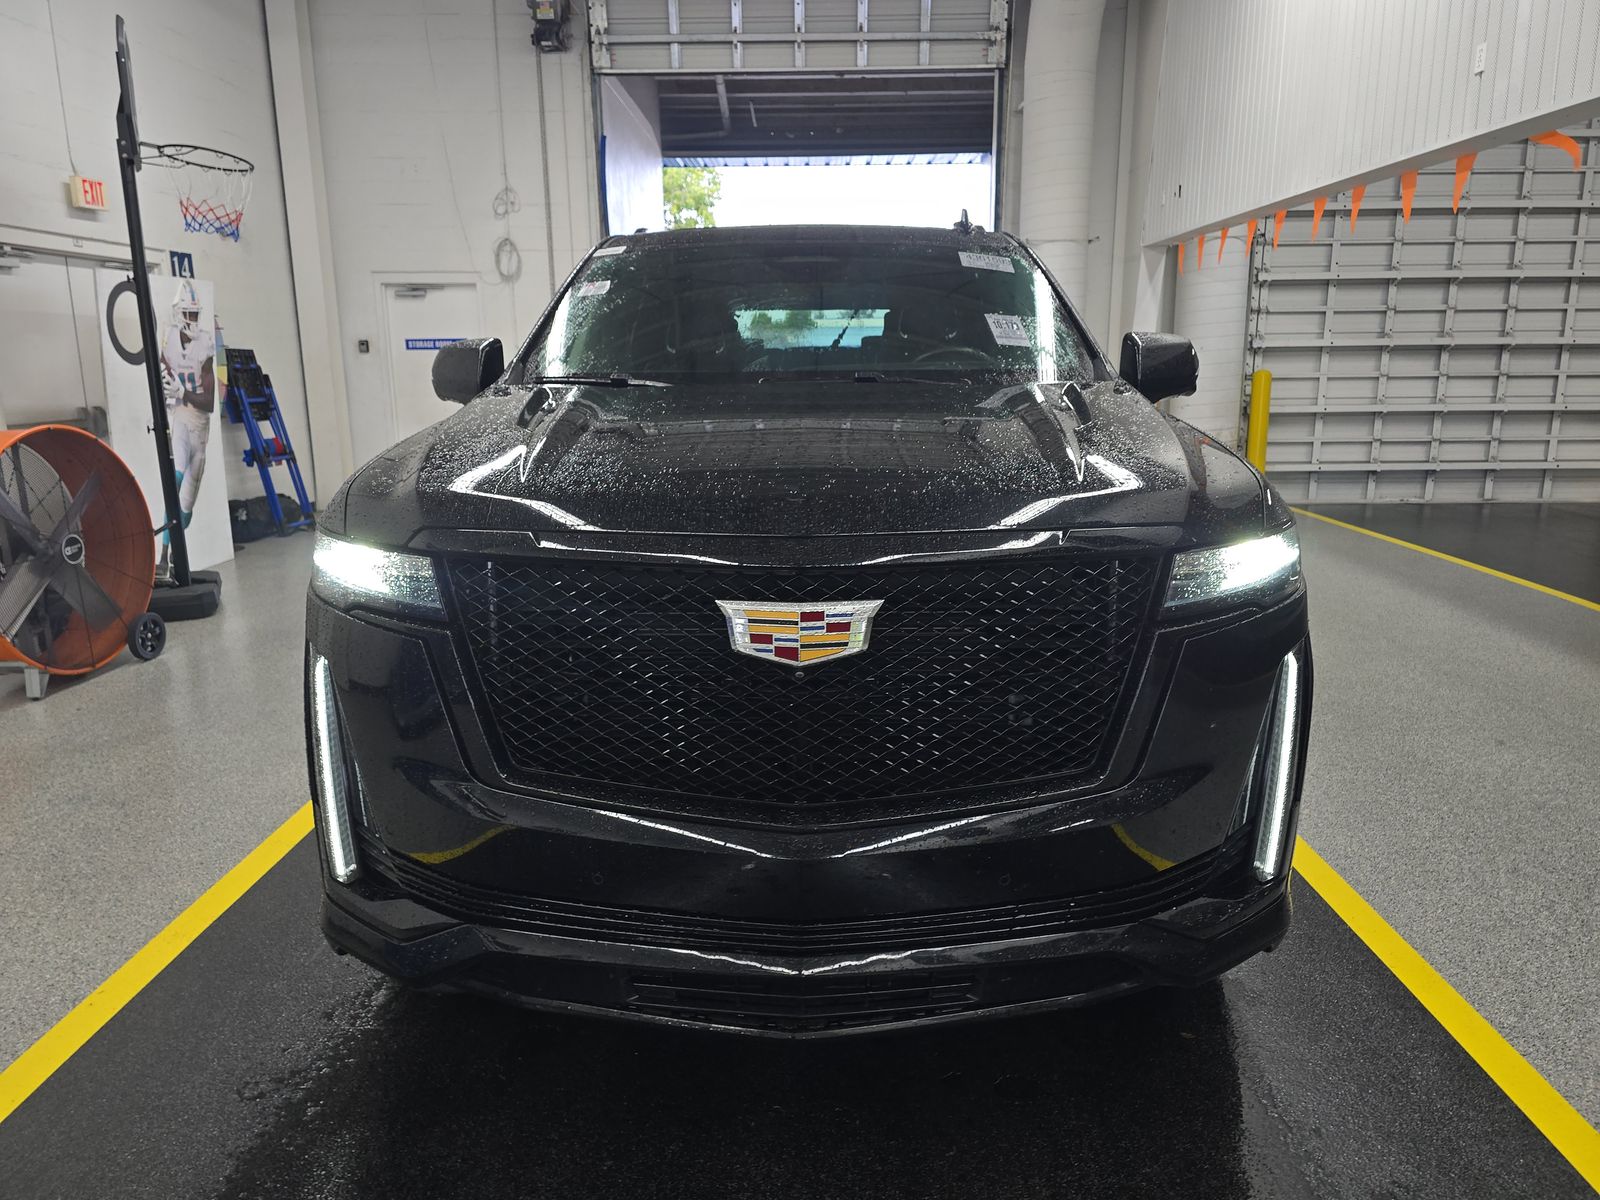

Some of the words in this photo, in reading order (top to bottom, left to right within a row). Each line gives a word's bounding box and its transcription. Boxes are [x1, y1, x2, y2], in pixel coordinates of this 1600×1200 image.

[82, 179, 104, 207] EXIT
[172, 255, 191, 278] 14
[408, 340, 434, 348] STORAGE
